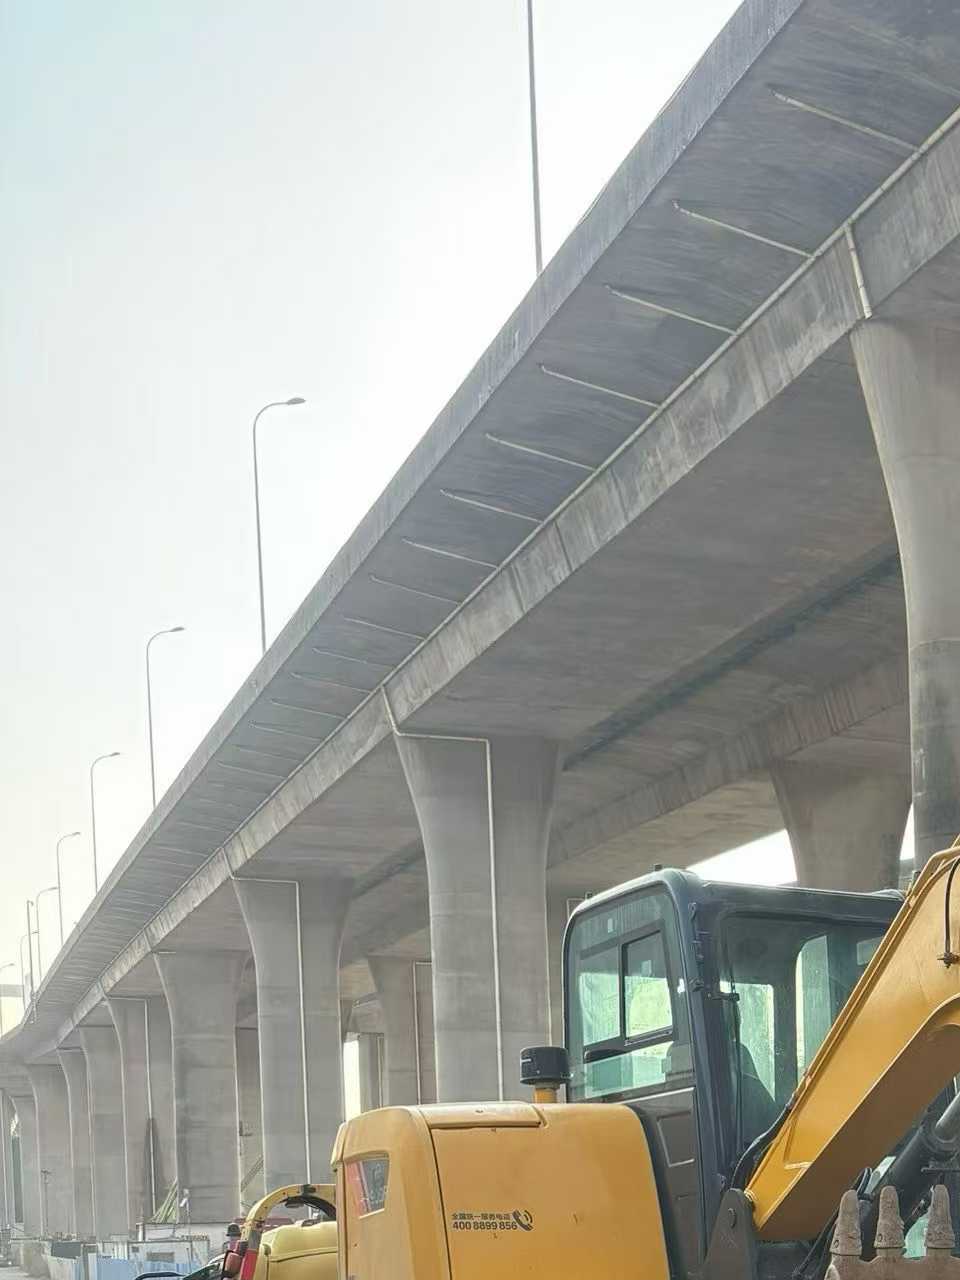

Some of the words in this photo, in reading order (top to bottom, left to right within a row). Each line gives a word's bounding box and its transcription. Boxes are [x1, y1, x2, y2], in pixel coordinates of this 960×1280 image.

[452, 1221, 472, 1230] 400
[473, 1221, 498, 1230] 8899
[499, 1221, 518, 1230] 856
